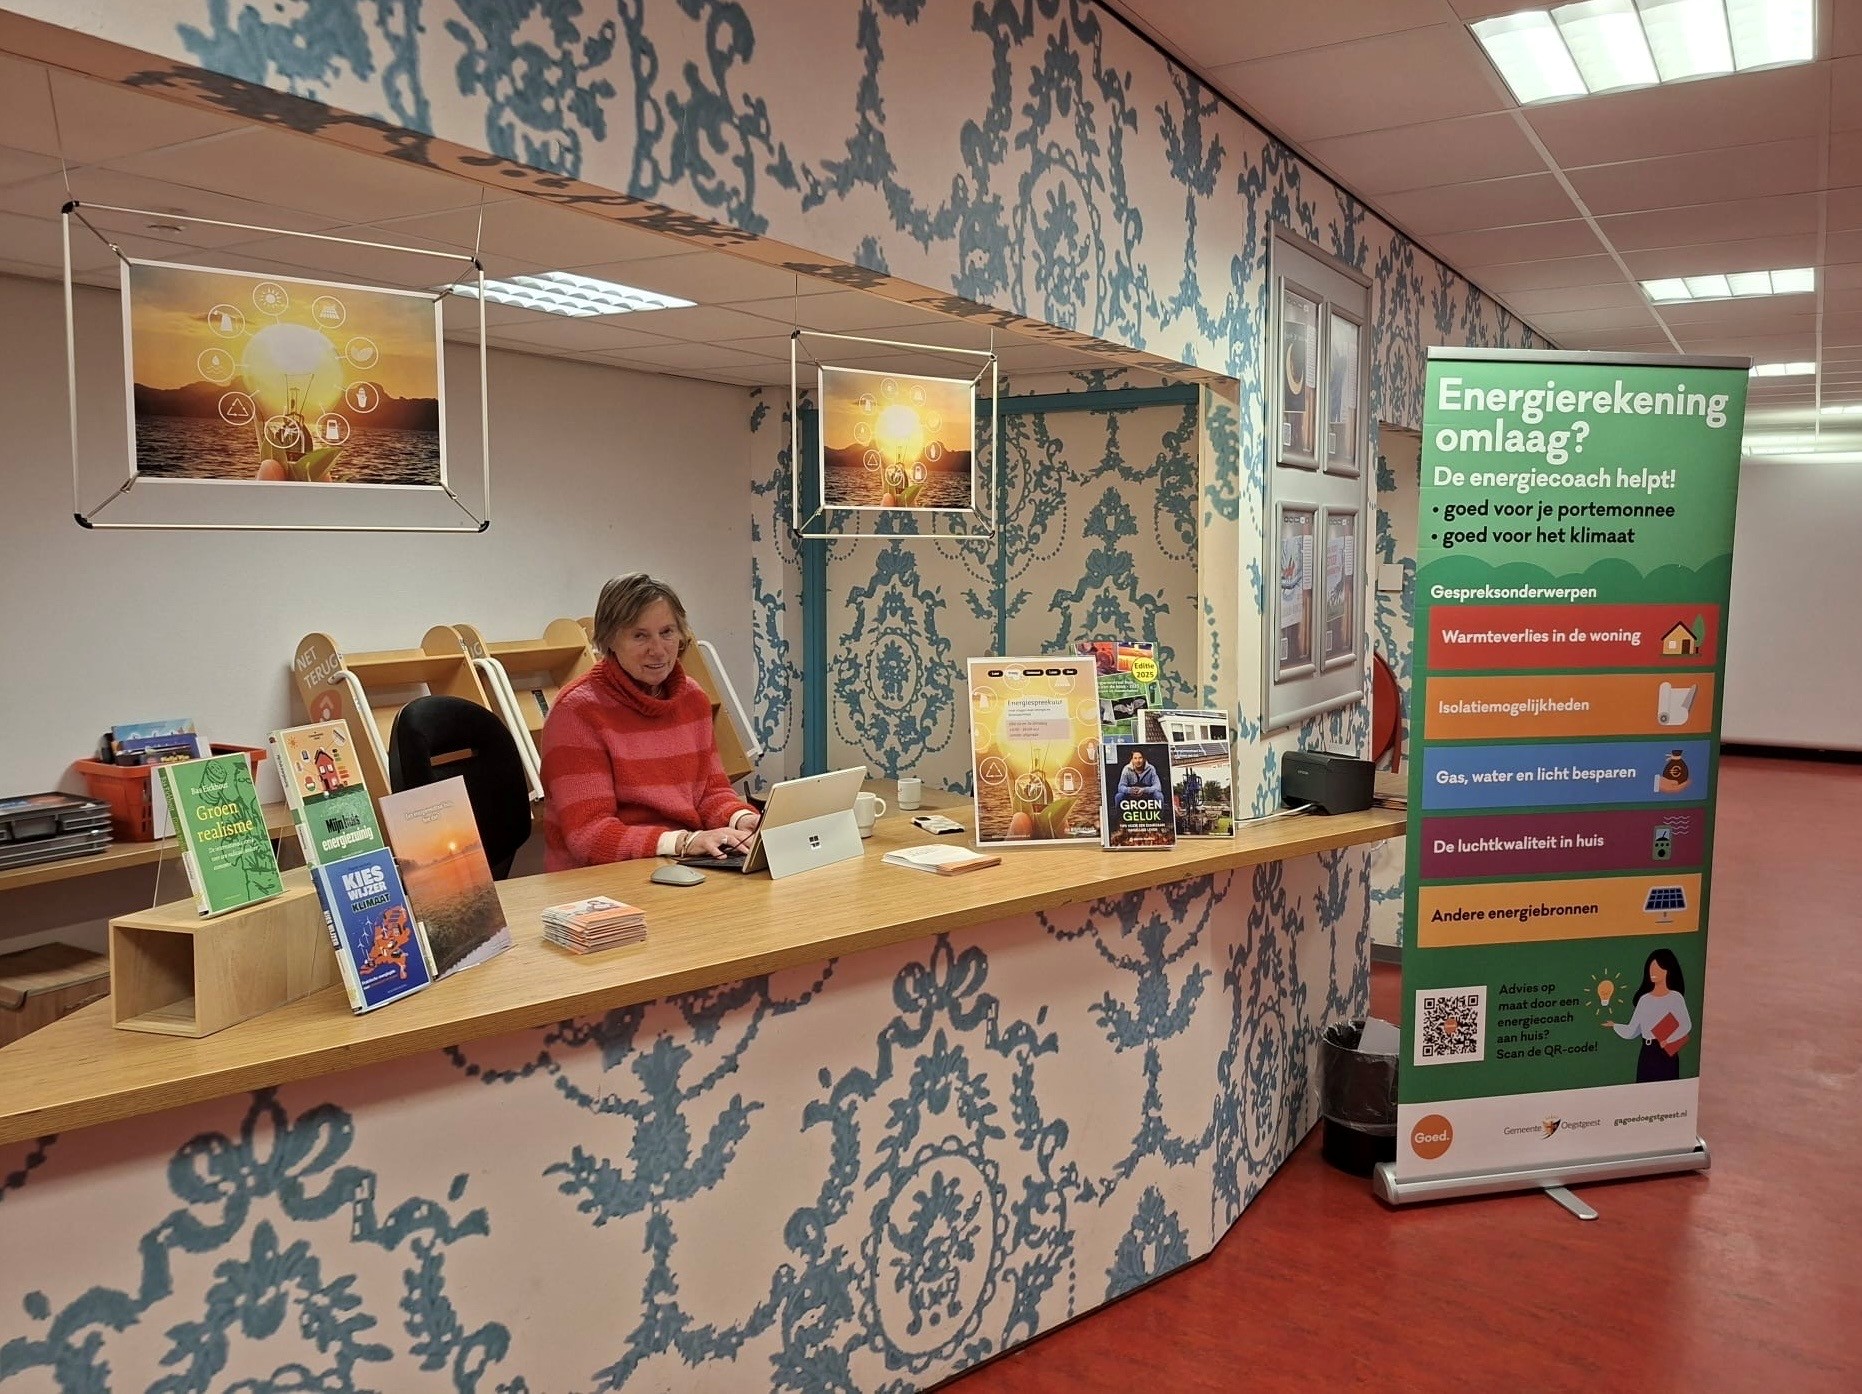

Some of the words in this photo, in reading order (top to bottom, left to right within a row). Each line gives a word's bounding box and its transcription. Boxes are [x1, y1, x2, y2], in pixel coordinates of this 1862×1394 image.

[1438, 377, 1729, 428] Energierekening
[1435, 418, 1590, 465] omlaag?
[1433, 466, 1464, 487] De
[1470, 467, 1610, 494] energiecoach
[1616, 468, 1676, 494] helpt!
[1444, 499, 1489, 521] goed
[1494, 503, 1534, 517] voor
[1536, 500, 1553, 521] je
[1558, 502, 1676, 521] portemonnee
[1443, 526, 1488, 548] goed
[1492, 531, 1532, 544] voor
[1537, 526, 1566, 543] het
[1570, 526, 1636, 543] klimaat
[1430, 584, 1597, 602] Gespreksonderwerpen
[1441, 629, 1549, 644] Warmteverlies
[1552, 629, 1566, 643] in
[1568, 628, 1587, 643] de
[1590, 629, 1642, 646] woning
[296, 646, 317, 671] NET
[1134, 662, 1155, 670] Editie
[1438, 698, 1590, 717] Isolatiemogelijkheden
[1436, 770, 1469, 785] Gas,
[1472, 769, 1513, 784] water
[1516, 770, 1534, 782] en
[1537, 767, 1569, 781] licht
[1572, 766, 1637, 783] besparen
[196, 802, 239, 821] Groen
[1120, 799, 1162, 810] GROEN
[325, 817, 345, 834] Mijn
[1122, 811, 1161, 821] GELUK
[197, 819, 254, 843] realisme
[321, 825, 374, 851] energiezuinig
[1433, 840, 1455, 854] De
[1457, 836, 1557, 853] luchtkwaliteit
[1559, 835, 1573, 848] in
[1576, 834, 1605, 848] huis
[341, 865, 384, 891] KIES
[347, 881, 387, 900] WIJZER
[351, 893, 390, 912] KLIMAAT
[1431, 909, 1485, 923] Andere
[1488, 903, 1599, 921] energiebronnen
[1499, 983, 1539, 995] Advies
[1541, 983, 1556, 994] op
[1498, 1000, 1529, 1011] maat
[1530, 998, 1557, 1009] door
[1559, 998, 1580, 1007] een
[1497, 1012, 1574, 1029] energiecoach
[1497, 1034, 1518, 1043] aan
[1520, 1029, 1550, 1041] huis?
[1496, 1048, 1525, 1059] Scan
[1527, 1046, 1541, 1057] de
[1544, 1041, 1598, 1057] QR-code!
[1503, 1124, 1542, 1135] Gemeente
[1561, 1118, 1601, 1130] Oegstgeest
[1613, 1110, 1688, 1126] gagoedoegstgeest.nl
[1414, 1130, 1451, 1143] Goed.
